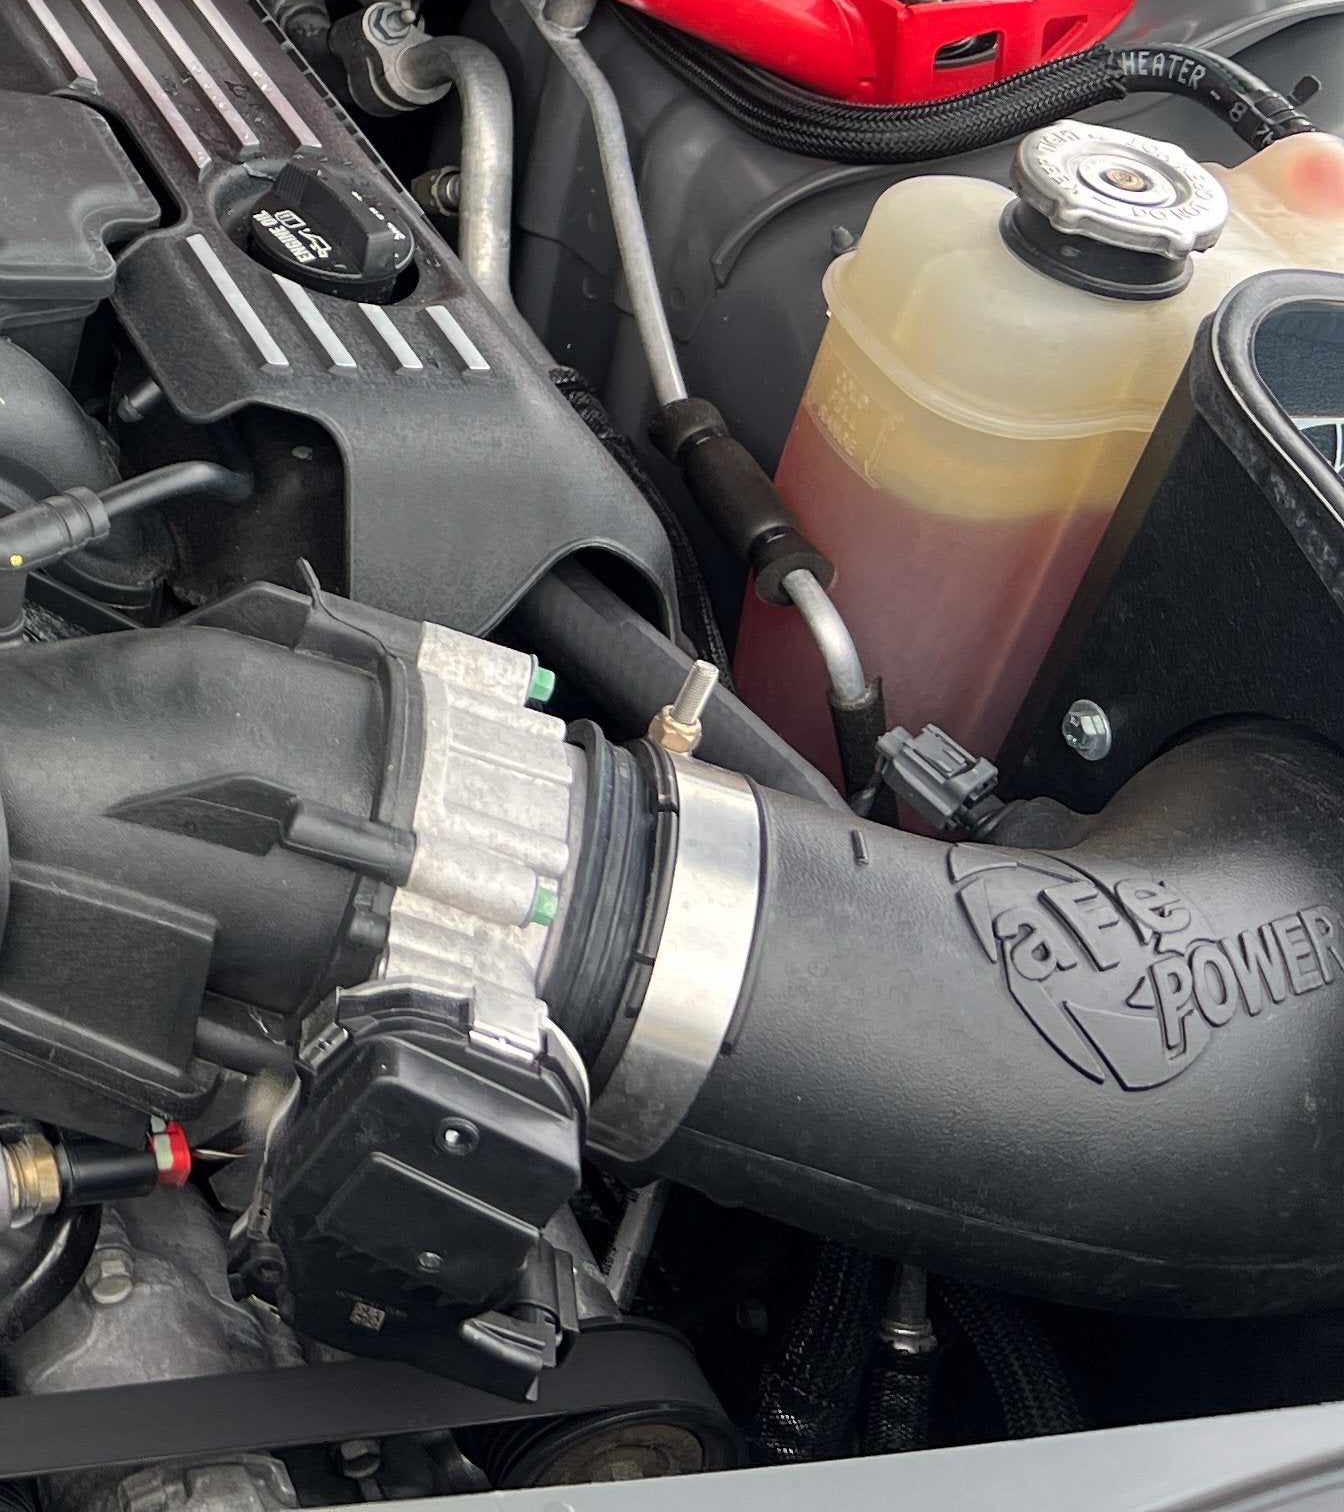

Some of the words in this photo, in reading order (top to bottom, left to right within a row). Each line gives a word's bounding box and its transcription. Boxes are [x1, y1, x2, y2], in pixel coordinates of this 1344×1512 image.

[1120, 51, 1207, 90] HEATER
[252, 209, 279, 228] OIL
[268, 224, 317, 264] ENGINE
[993, 877, 1192, 982] aFe
[1147, 903, 1344, 1051] POWER
